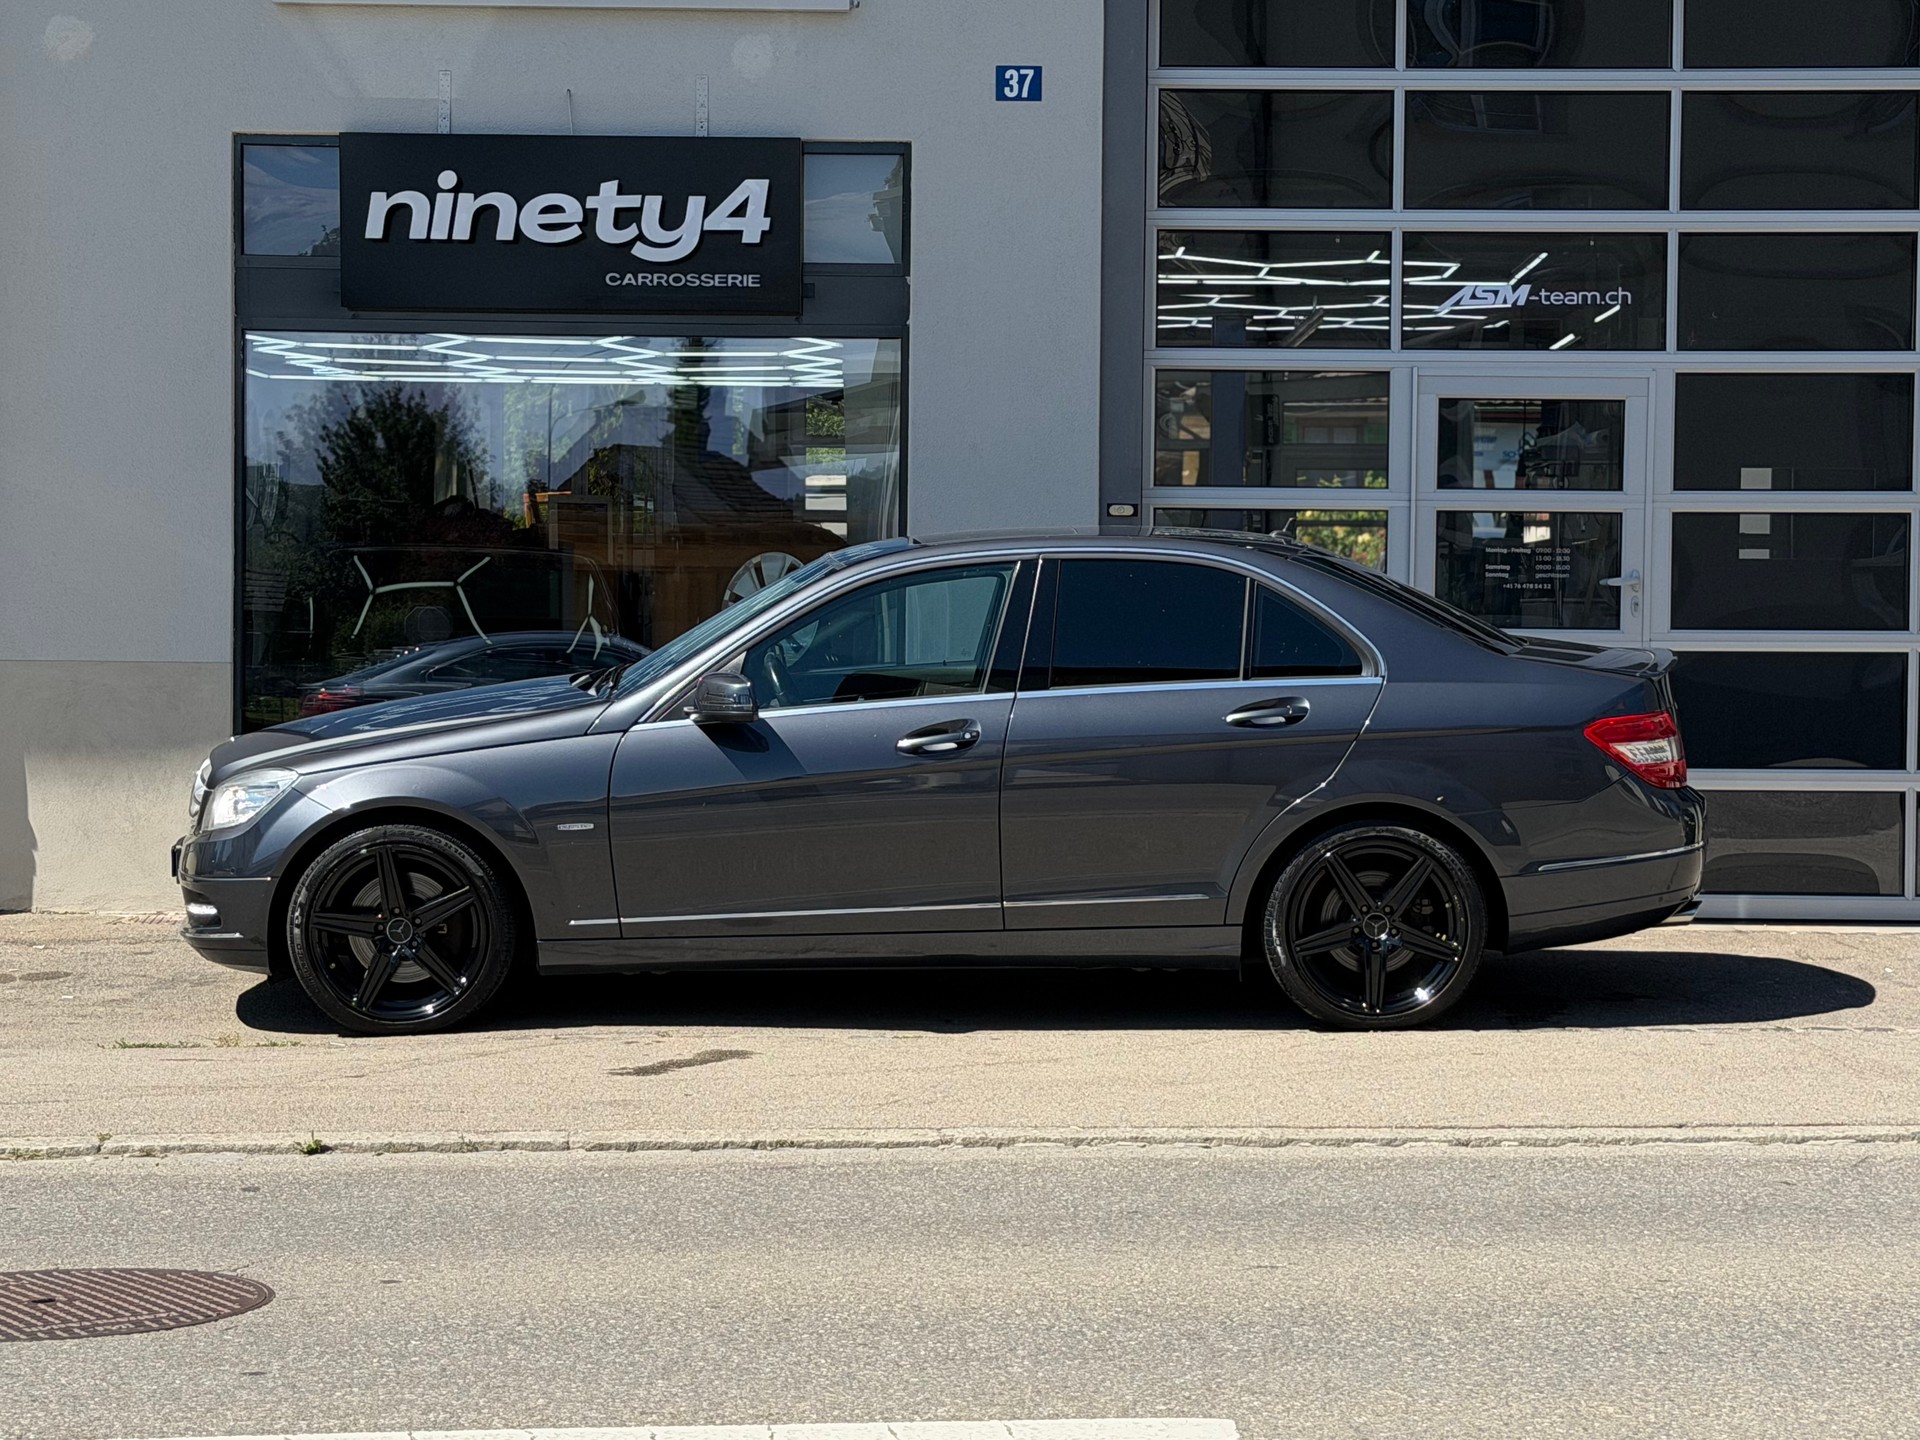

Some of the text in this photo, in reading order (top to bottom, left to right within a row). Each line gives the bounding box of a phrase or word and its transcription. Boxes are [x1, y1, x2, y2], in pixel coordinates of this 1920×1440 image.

[1003, 68, 1035, 99] 37
[364, 169, 772, 263] ninety4
[604, 272, 761, 288] CARROSSERIE
[1485, 563, 1511, 571] Samstag
[1485, 571, 1509, 579] Sonntag
